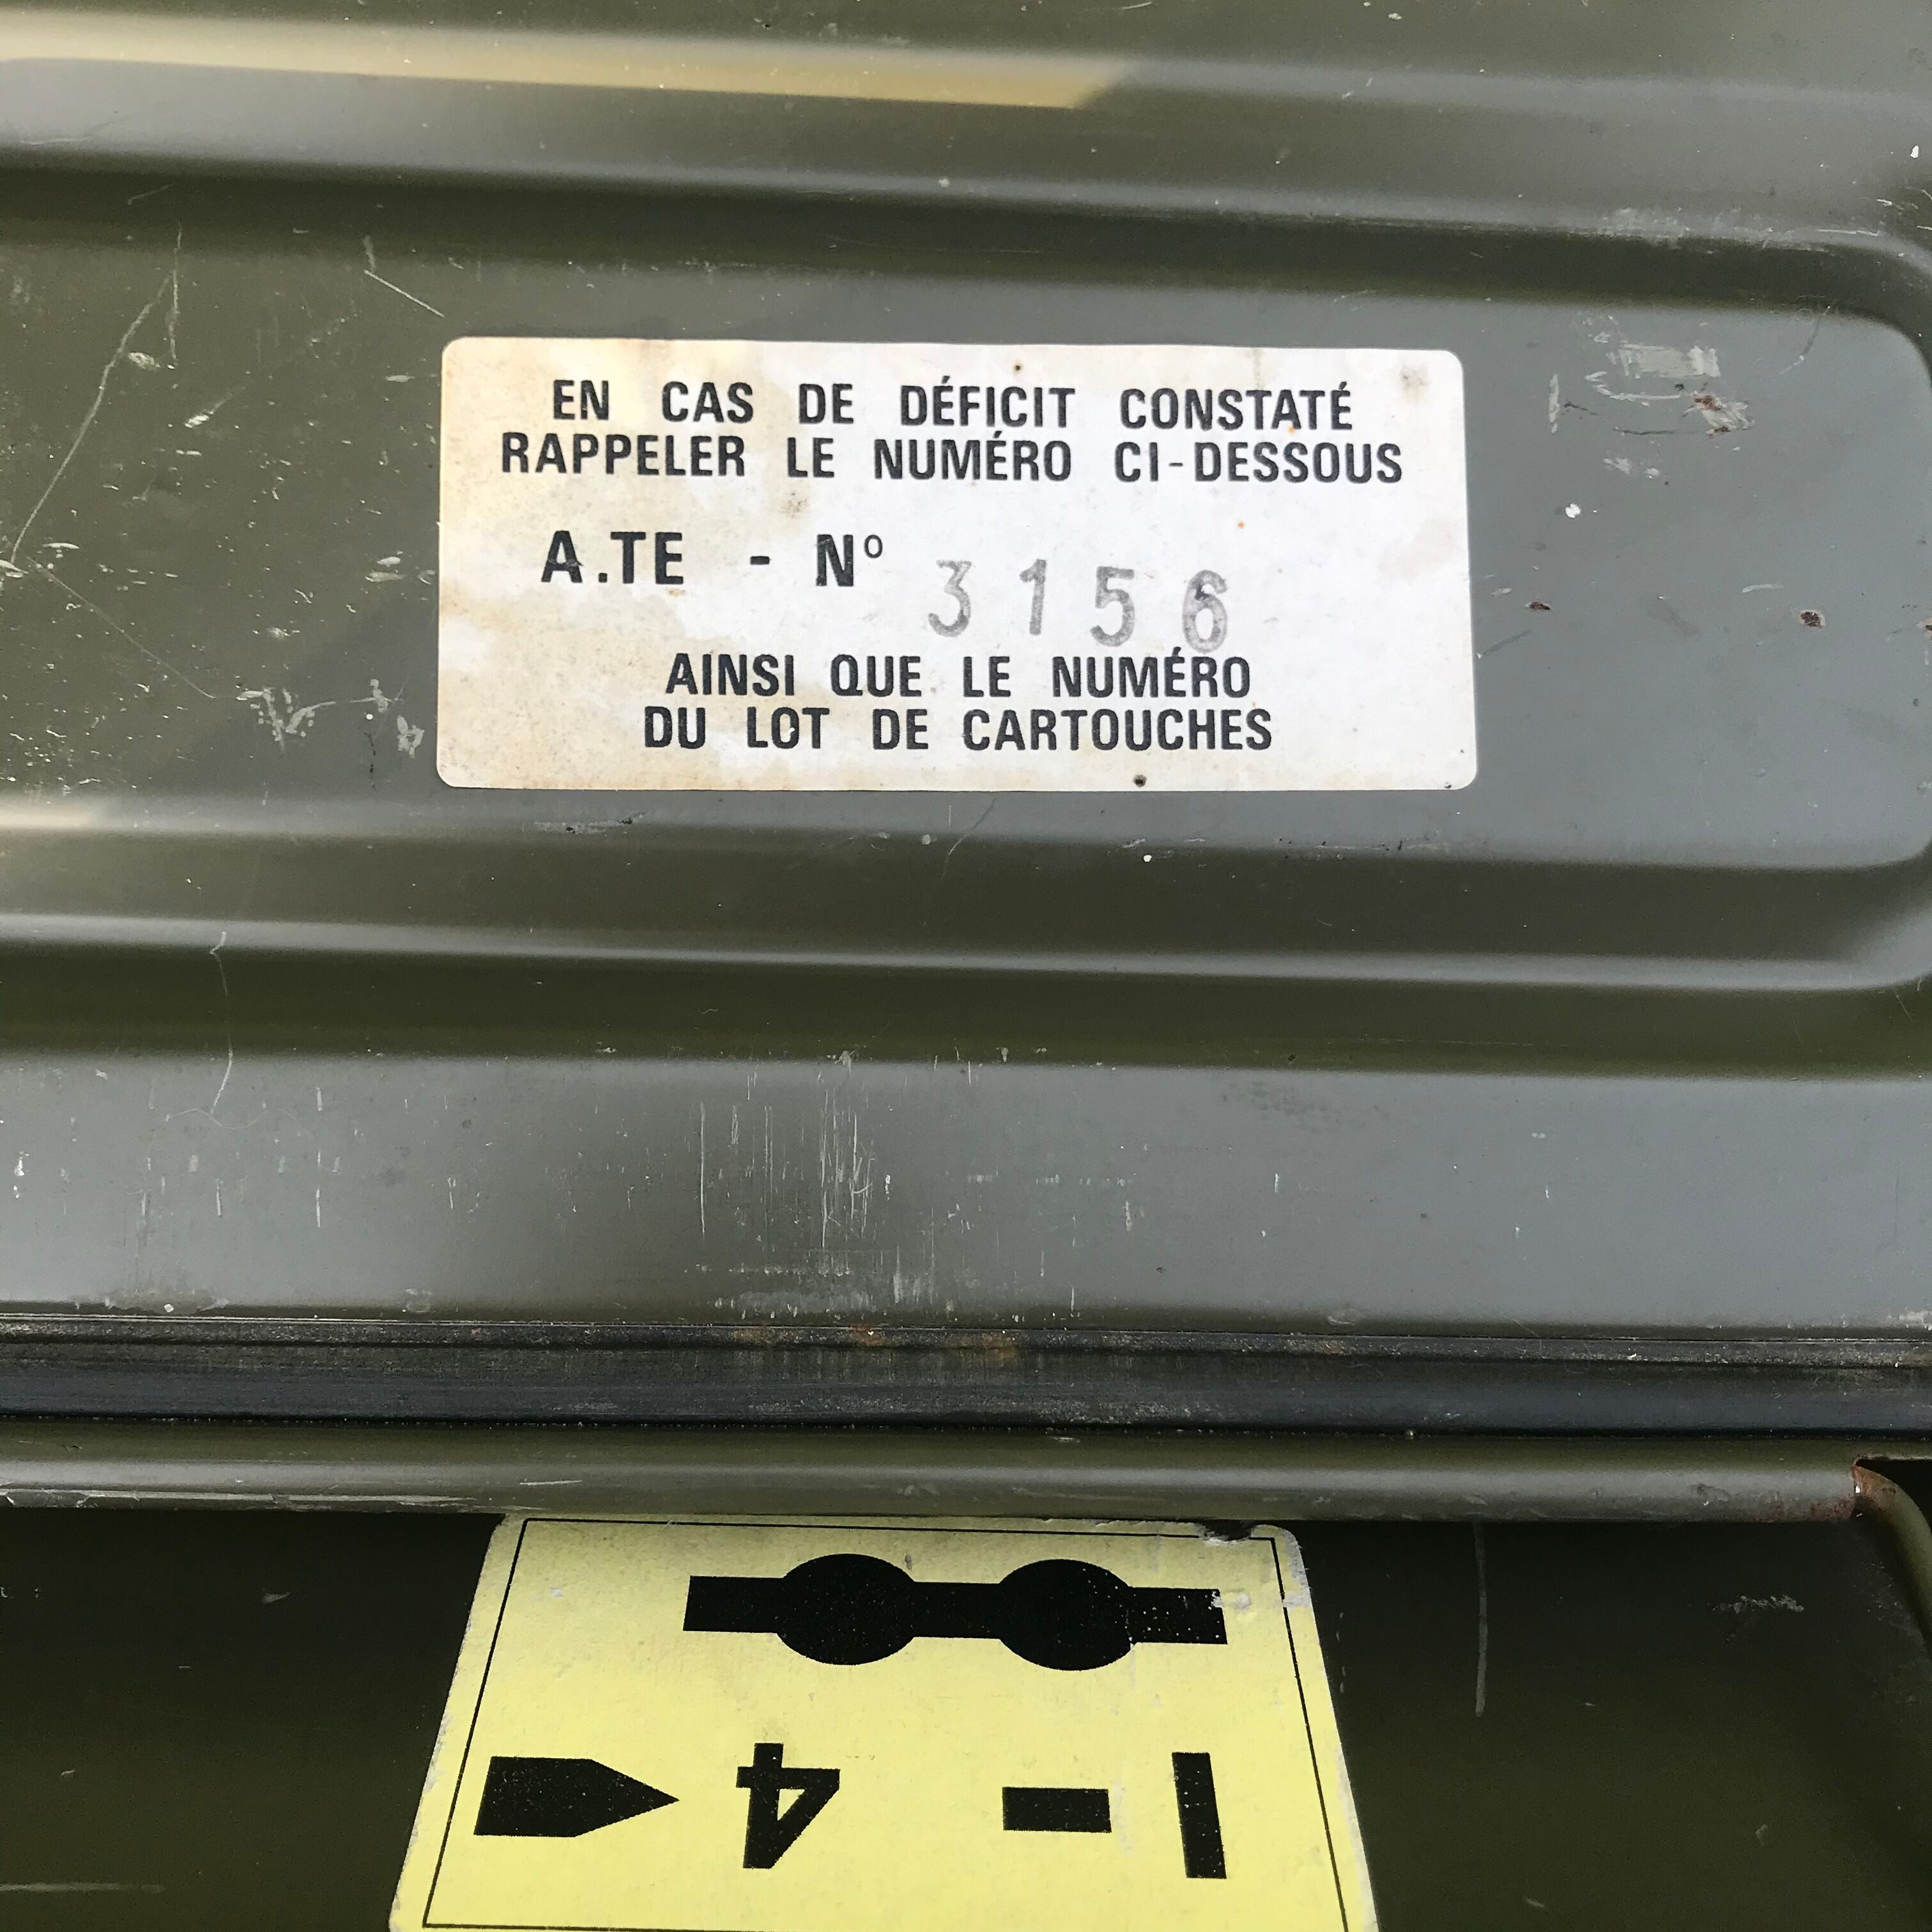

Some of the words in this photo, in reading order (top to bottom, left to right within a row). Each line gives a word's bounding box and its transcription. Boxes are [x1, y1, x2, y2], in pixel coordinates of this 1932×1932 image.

[553, 379, 610, 421] EN
[661, 380, 754, 424] CAS
[798, 383, 855, 424] DE
[900, 376, 1076, 428] DÉFICIT
[1120, 381, 1353, 431] CONSTATÉ
[502, 431, 745, 477] RAPPELER
[786, 436, 835, 479] LE
[873, 429, 1072, 482] NUMÉRO
[1115, 441, 1402, 484] CI-DESSOUS
[540, 529, 684, 585] A.TE
[664, 652, 795, 697] AINSI
[830, 653, 923, 698] QUE
[963, 656, 1012, 698] LE
[1052, 646, 1251, 699] NUMÉRO
[643, 705, 707, 750] DU
[746, 705, 831, 750] LOT
[871, 708, 930, 751] DE
[962, 708, 1273, 752] CARTOUCHES
[735, 1742, 840, 1869] 4
